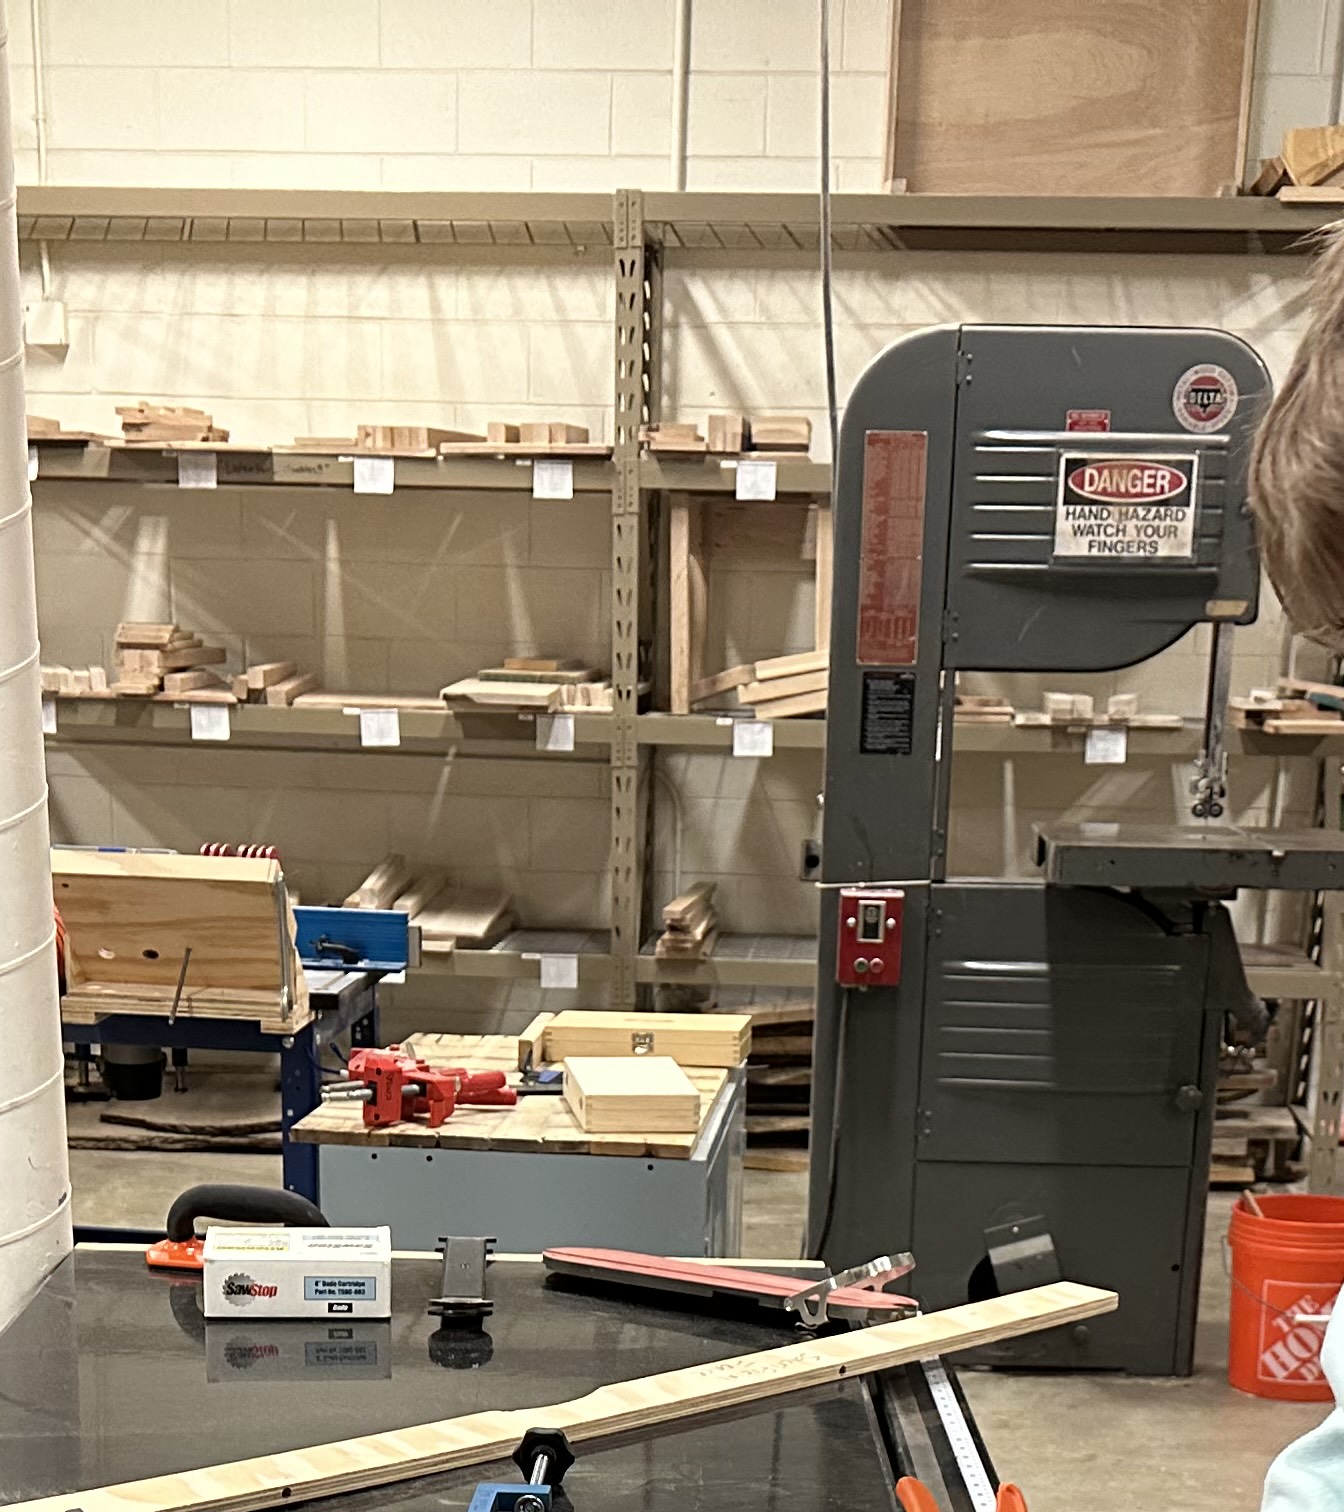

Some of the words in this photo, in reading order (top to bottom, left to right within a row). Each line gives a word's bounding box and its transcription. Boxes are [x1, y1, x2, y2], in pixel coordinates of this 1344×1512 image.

[1083, 467, 1172, 494] DANGER
[1064, 507, 1112, 522] HAND
[1117, 507, 1187, 522] HAZARD
[1071, 523, 1127, 538] WATCH
[1134, 524, 1179, 539] YOUR
[1087, 540, 1160, 554] FINGERS
[226, 1281, 278, 1298] SawStop
